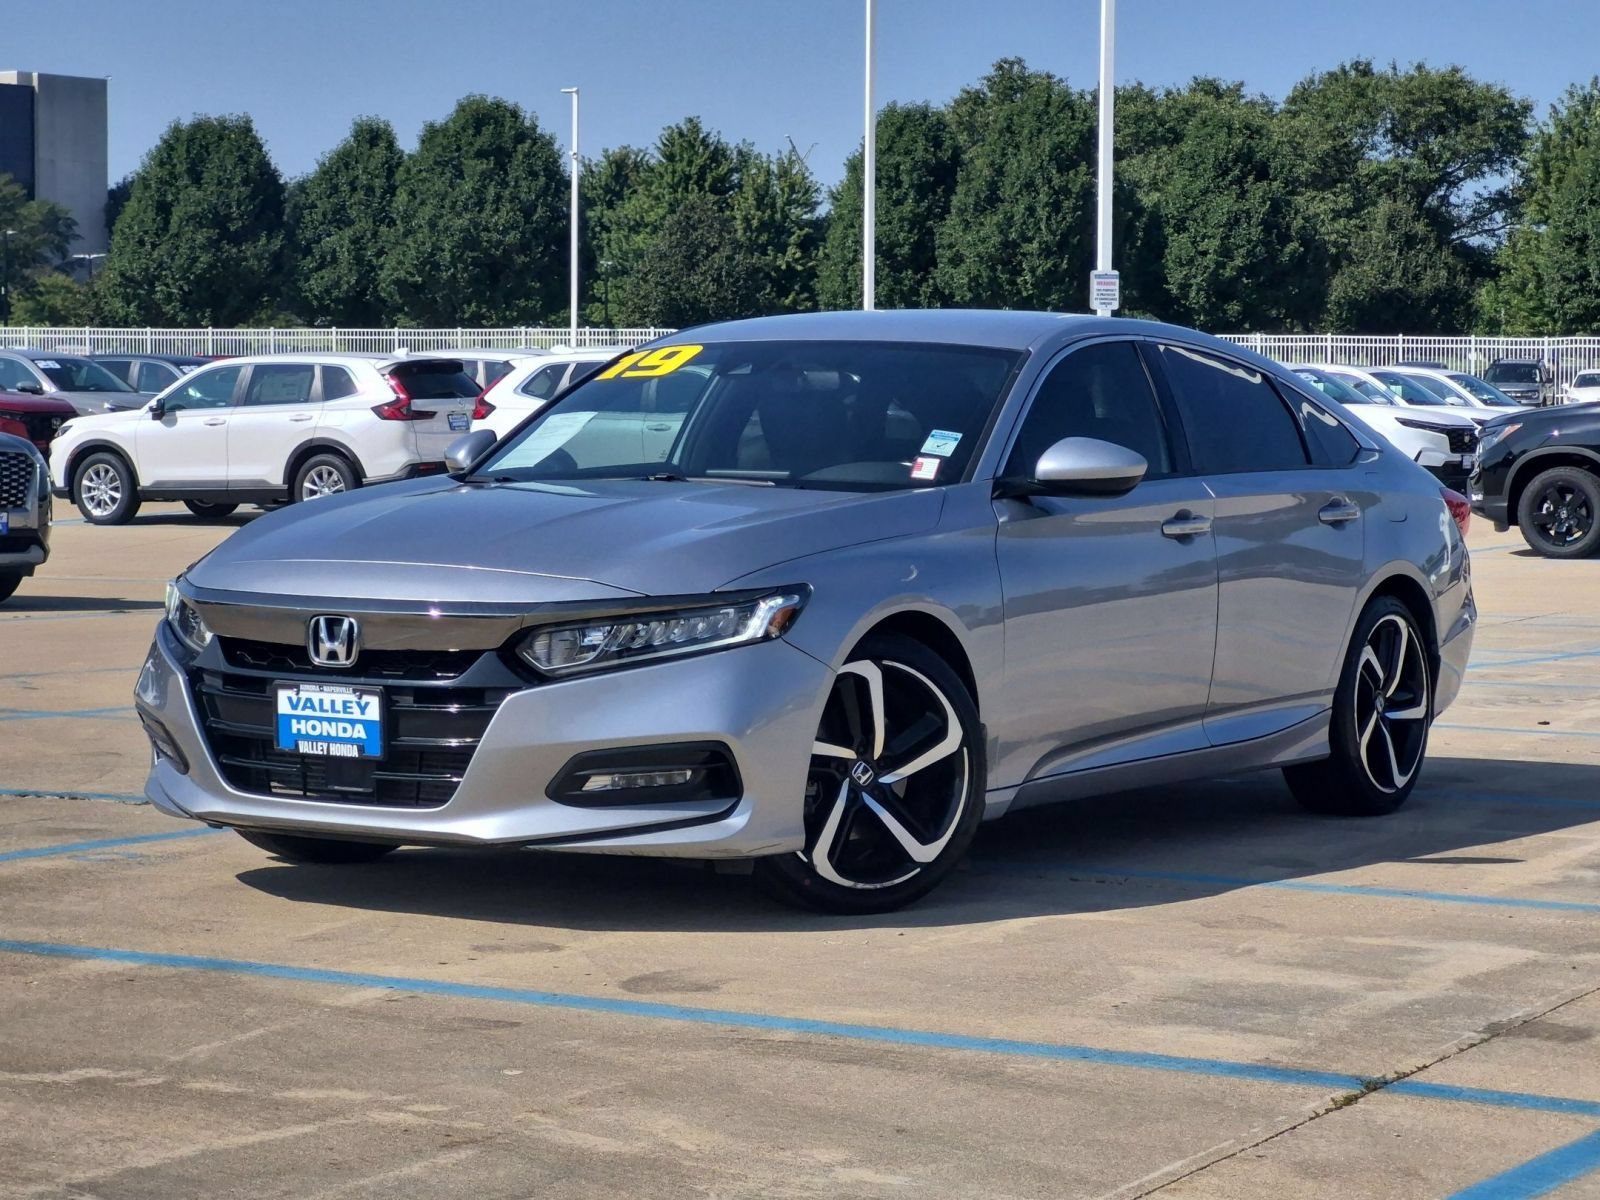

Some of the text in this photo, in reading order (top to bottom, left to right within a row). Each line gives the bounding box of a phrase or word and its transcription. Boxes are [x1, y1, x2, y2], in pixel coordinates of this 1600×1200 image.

[594, 345, 704, 381] 19
[287, 696, 370, 715] VALLEY
[291, 718, 367, 739] HONDA
[299, 741, 359, 758] VALLEY HONDA
